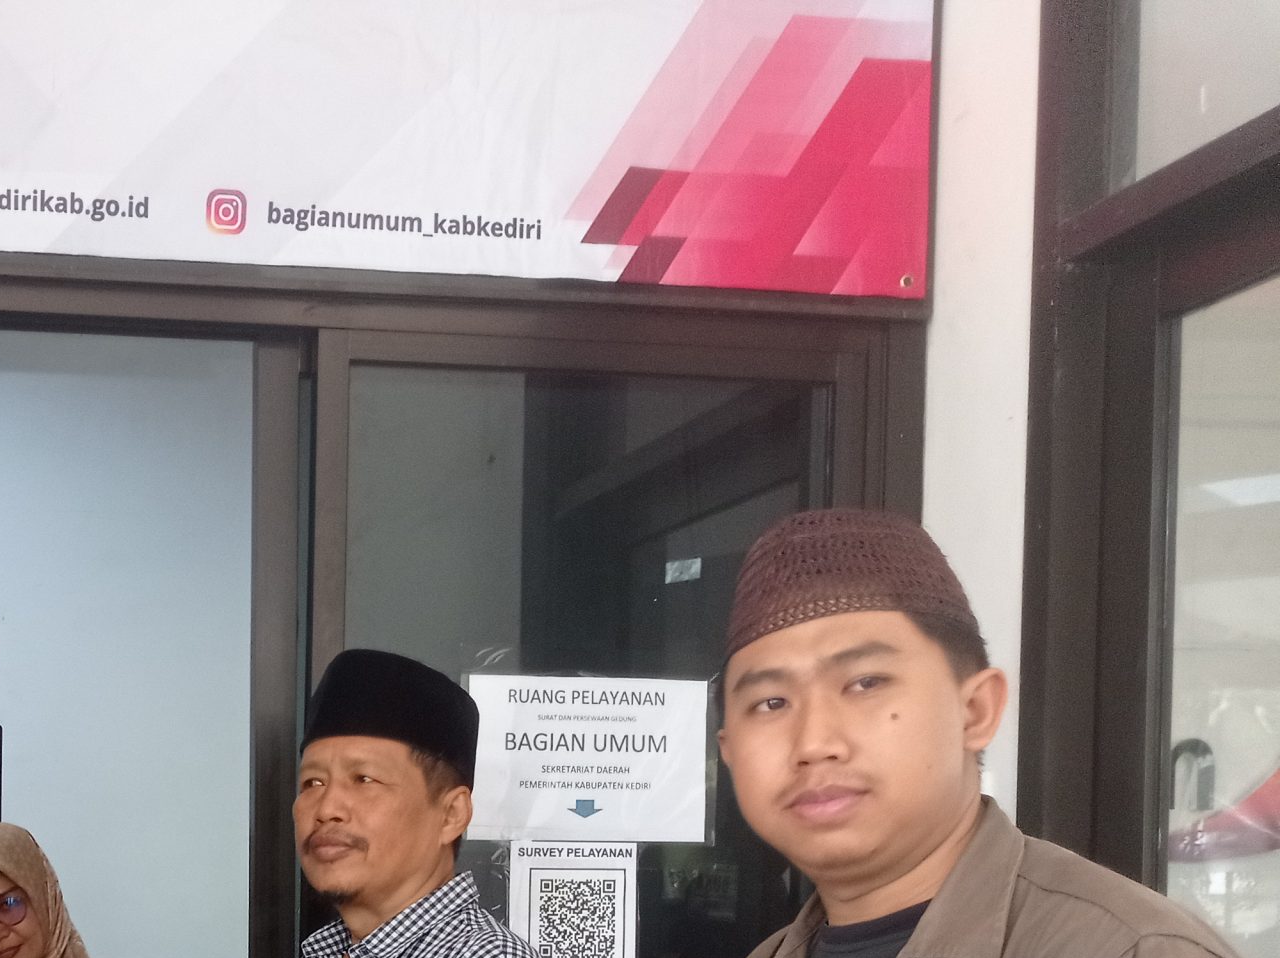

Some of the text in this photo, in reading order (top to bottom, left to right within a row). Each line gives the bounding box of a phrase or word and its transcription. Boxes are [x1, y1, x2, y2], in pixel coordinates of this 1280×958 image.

[267, 201, 542, 240] bagianumum_kabkediri
[508, 689, 665, 706] RUANG PELAYANAN
[505, 732, 667, 753] BAGIAN UMUM
[541, 765, 630, 775] SEKRETARIAT DAERAH
[519, 780, 652, 791] PEMERINTAH KABUPATEN KEDIRI
[517, 847, 633, 859] SURVEY PELAYANAN
